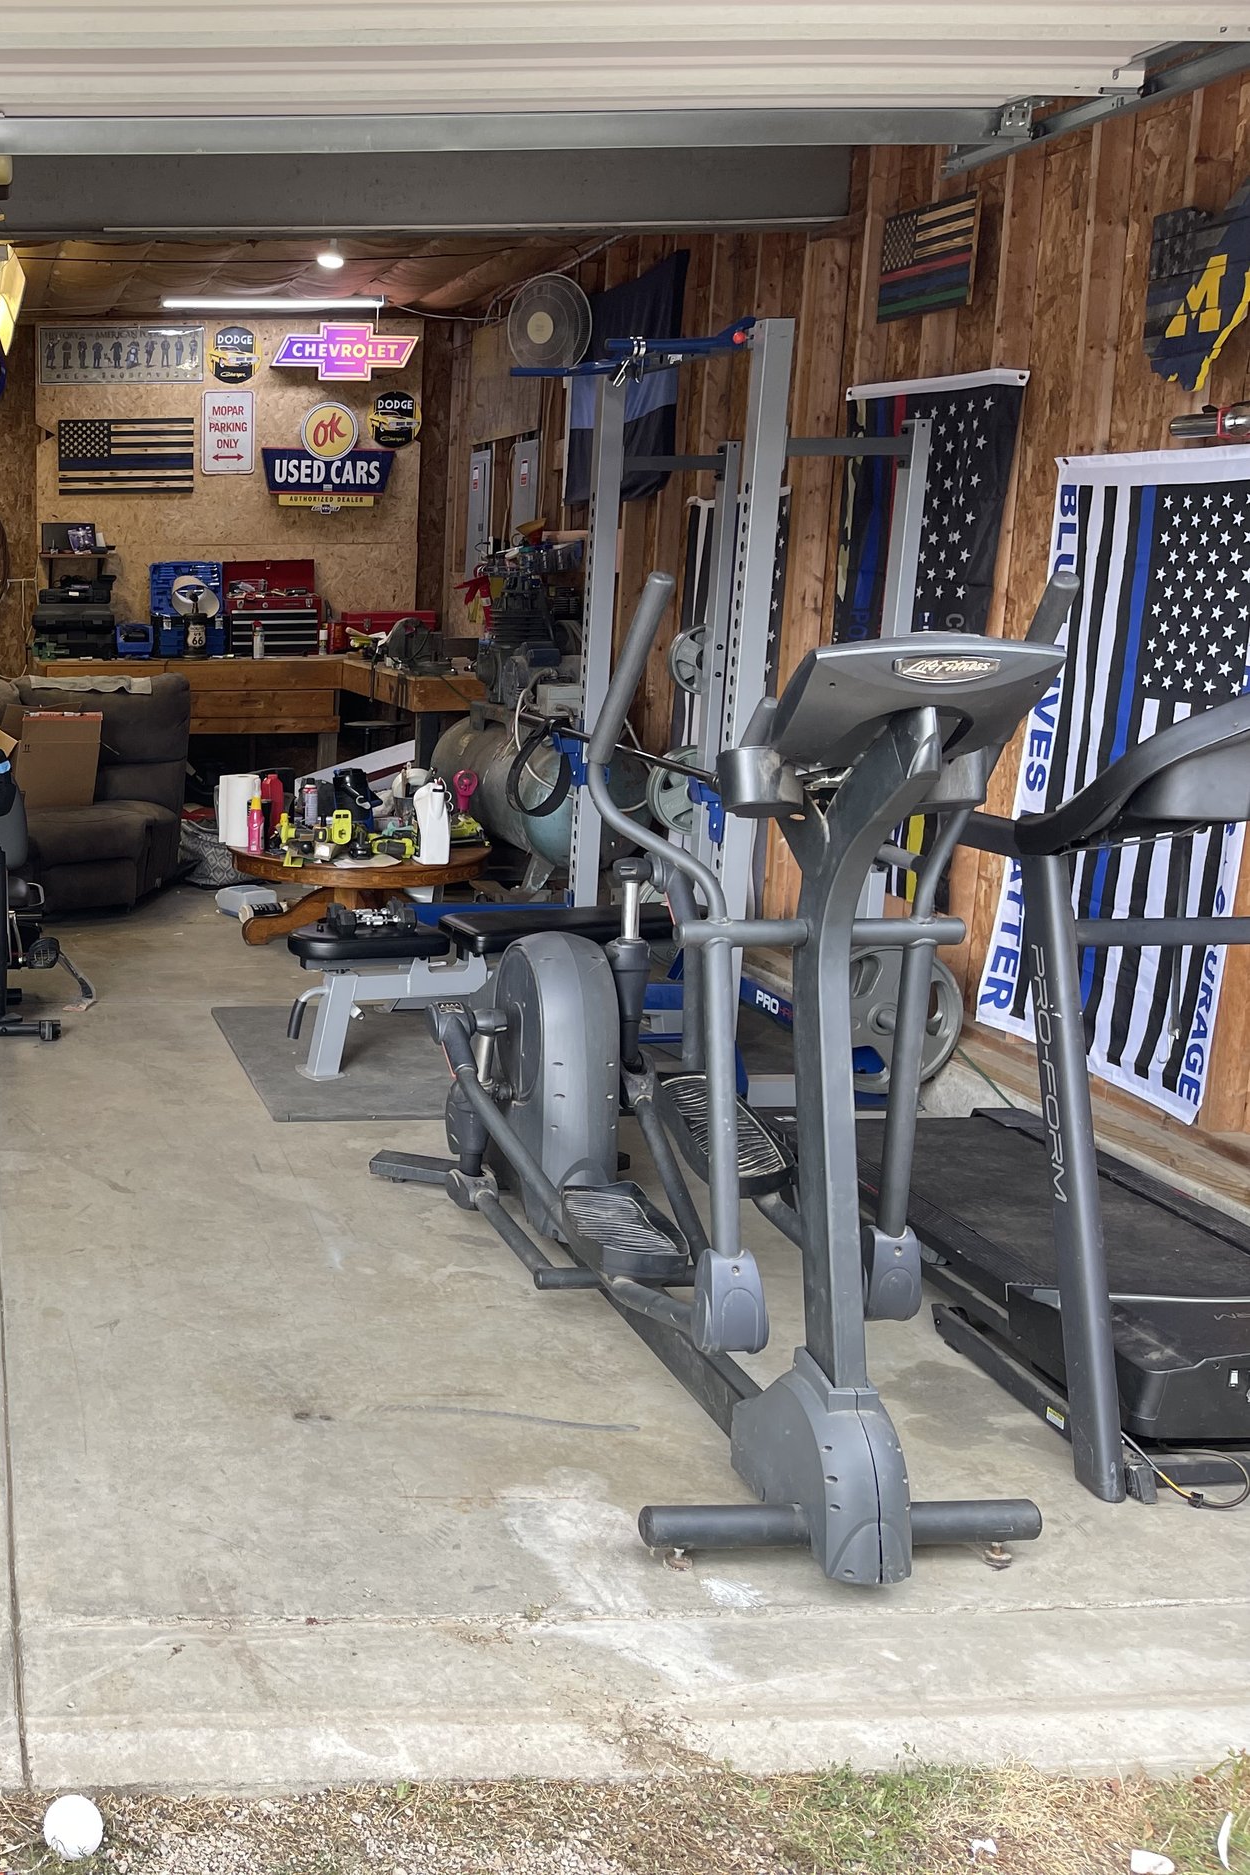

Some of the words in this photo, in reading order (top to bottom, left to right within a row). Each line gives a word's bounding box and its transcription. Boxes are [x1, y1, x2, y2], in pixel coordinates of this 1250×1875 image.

[217, 335, 253, 344] DODGE
[292, 343, 398, 358] CHEVROLET
[378, 400, 413, 409] DODGE
[212, 406, 244, 416] MOPAR
[209, 422, 247, 432] PARKING
[313, 412, 347, 447] OK
[216, 439, 239, 449] ONLY
[274, 459, 326, 484] USED
[330, 461, 380, 485] CARS
[192, 636, 203, 645] 66
